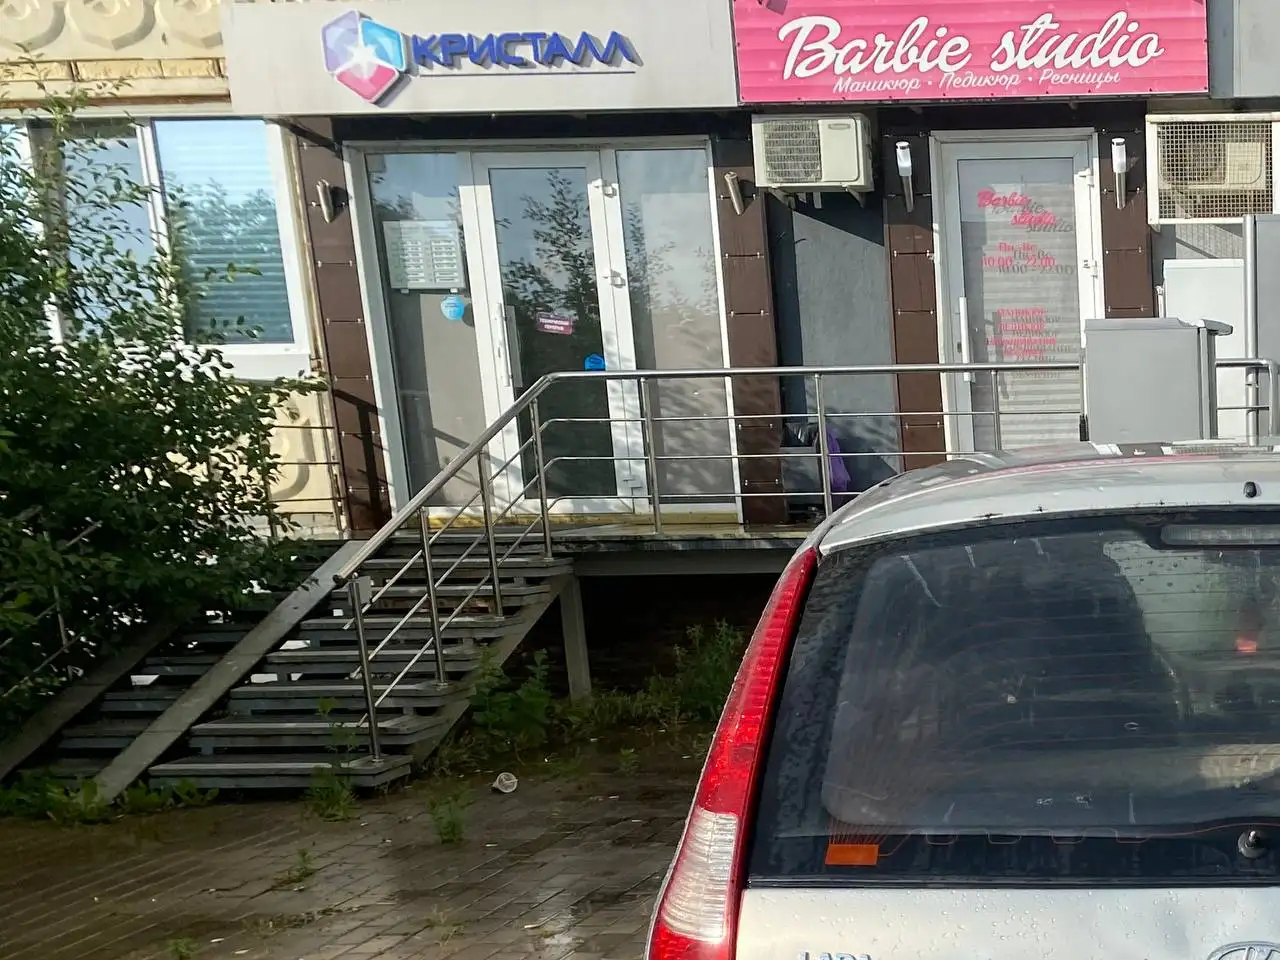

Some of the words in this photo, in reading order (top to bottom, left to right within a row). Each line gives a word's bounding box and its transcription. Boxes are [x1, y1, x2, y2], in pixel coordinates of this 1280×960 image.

[412, 31, 641, 67] КРИСТАЛЛ
[778, 15, 972, 80] Barbie
[991, 11, 1165, 73] studio
[833, 77, 921, 94] Маникюр
[939, 72, 1021, 93] Педикюр
[1038, 69, 1121, 91] Ресницы
